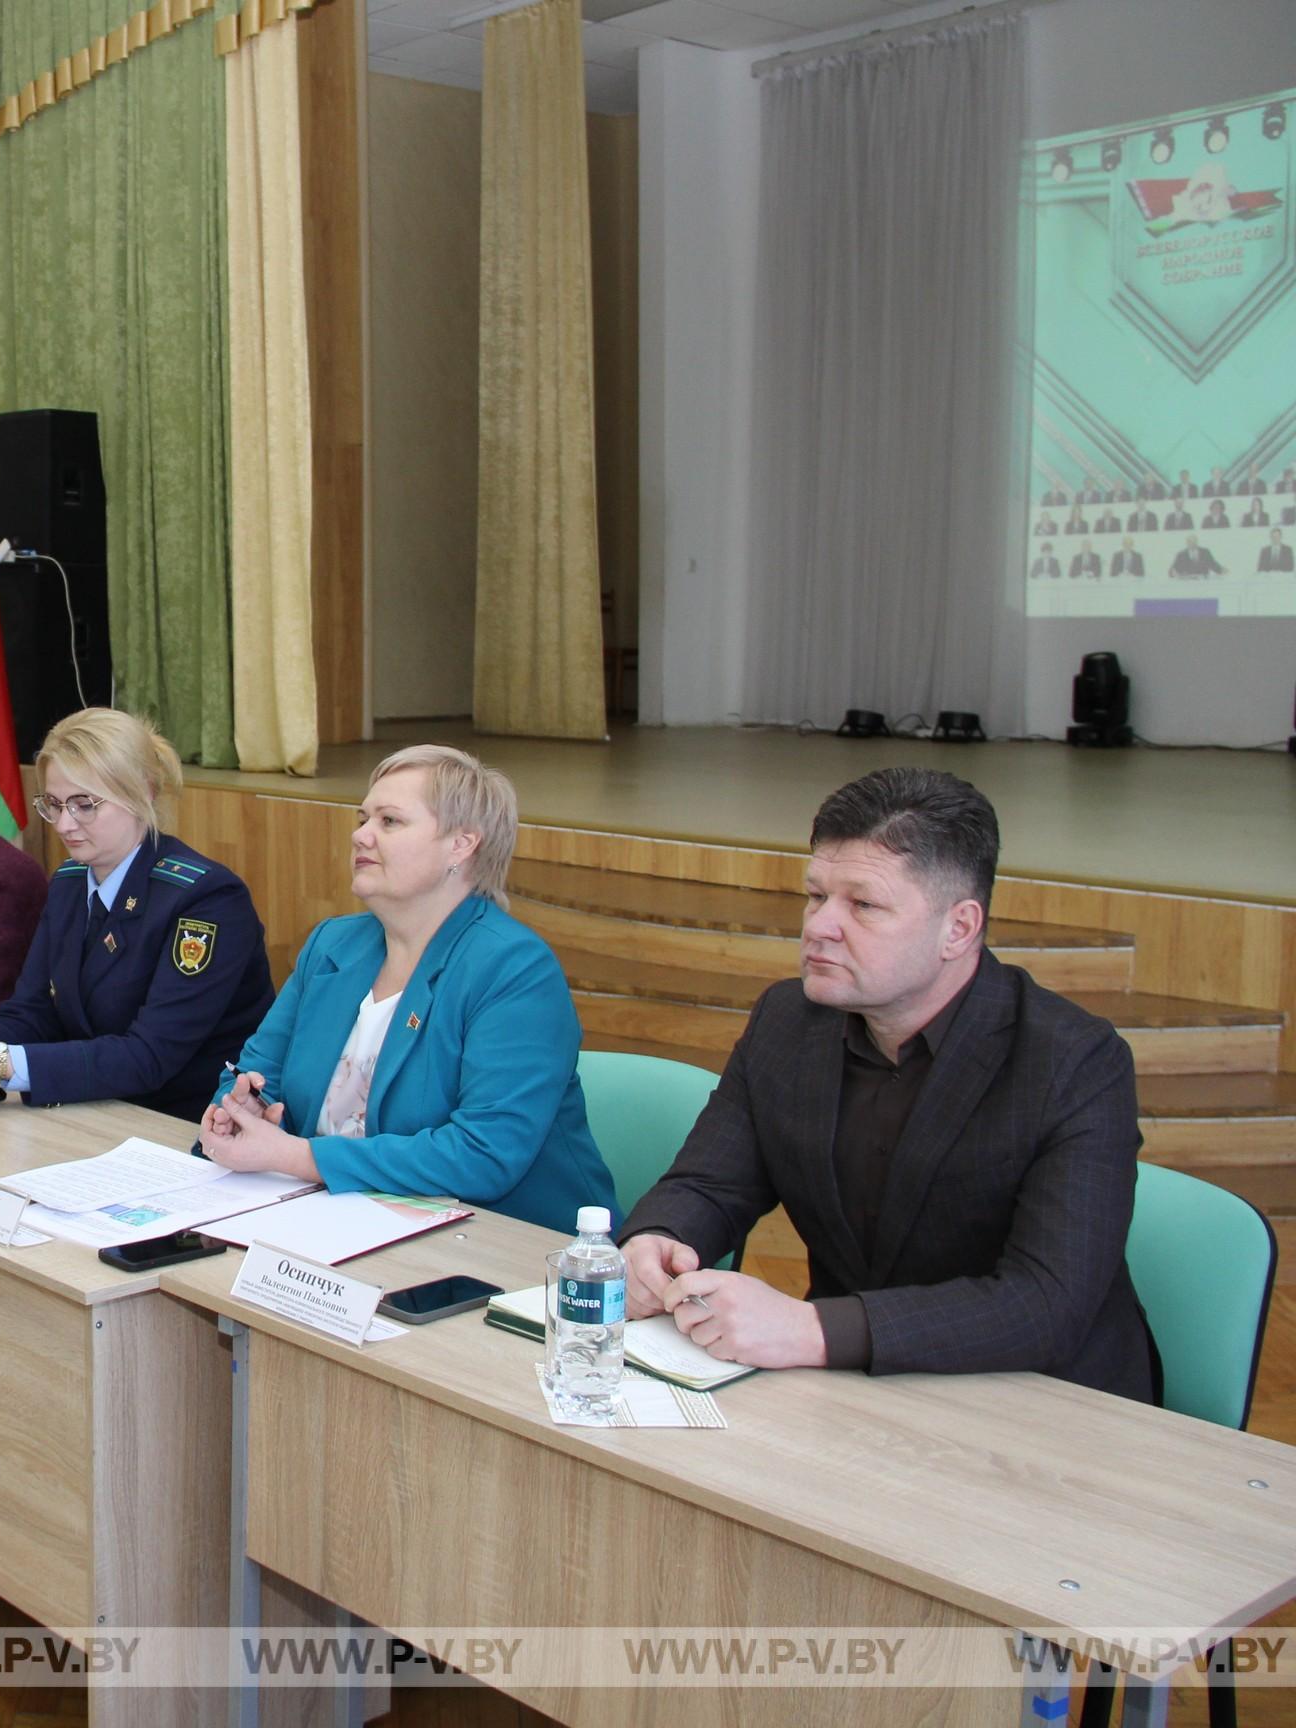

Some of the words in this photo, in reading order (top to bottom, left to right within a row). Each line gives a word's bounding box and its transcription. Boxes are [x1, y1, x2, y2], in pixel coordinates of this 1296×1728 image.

[260, 1274, 303, 1298] Валентин
[304, 1291, 349, 1316] Павлович
[277, 1259, 345, 1297] Осипчук
[571, 1297, 601, 1309] WATER
